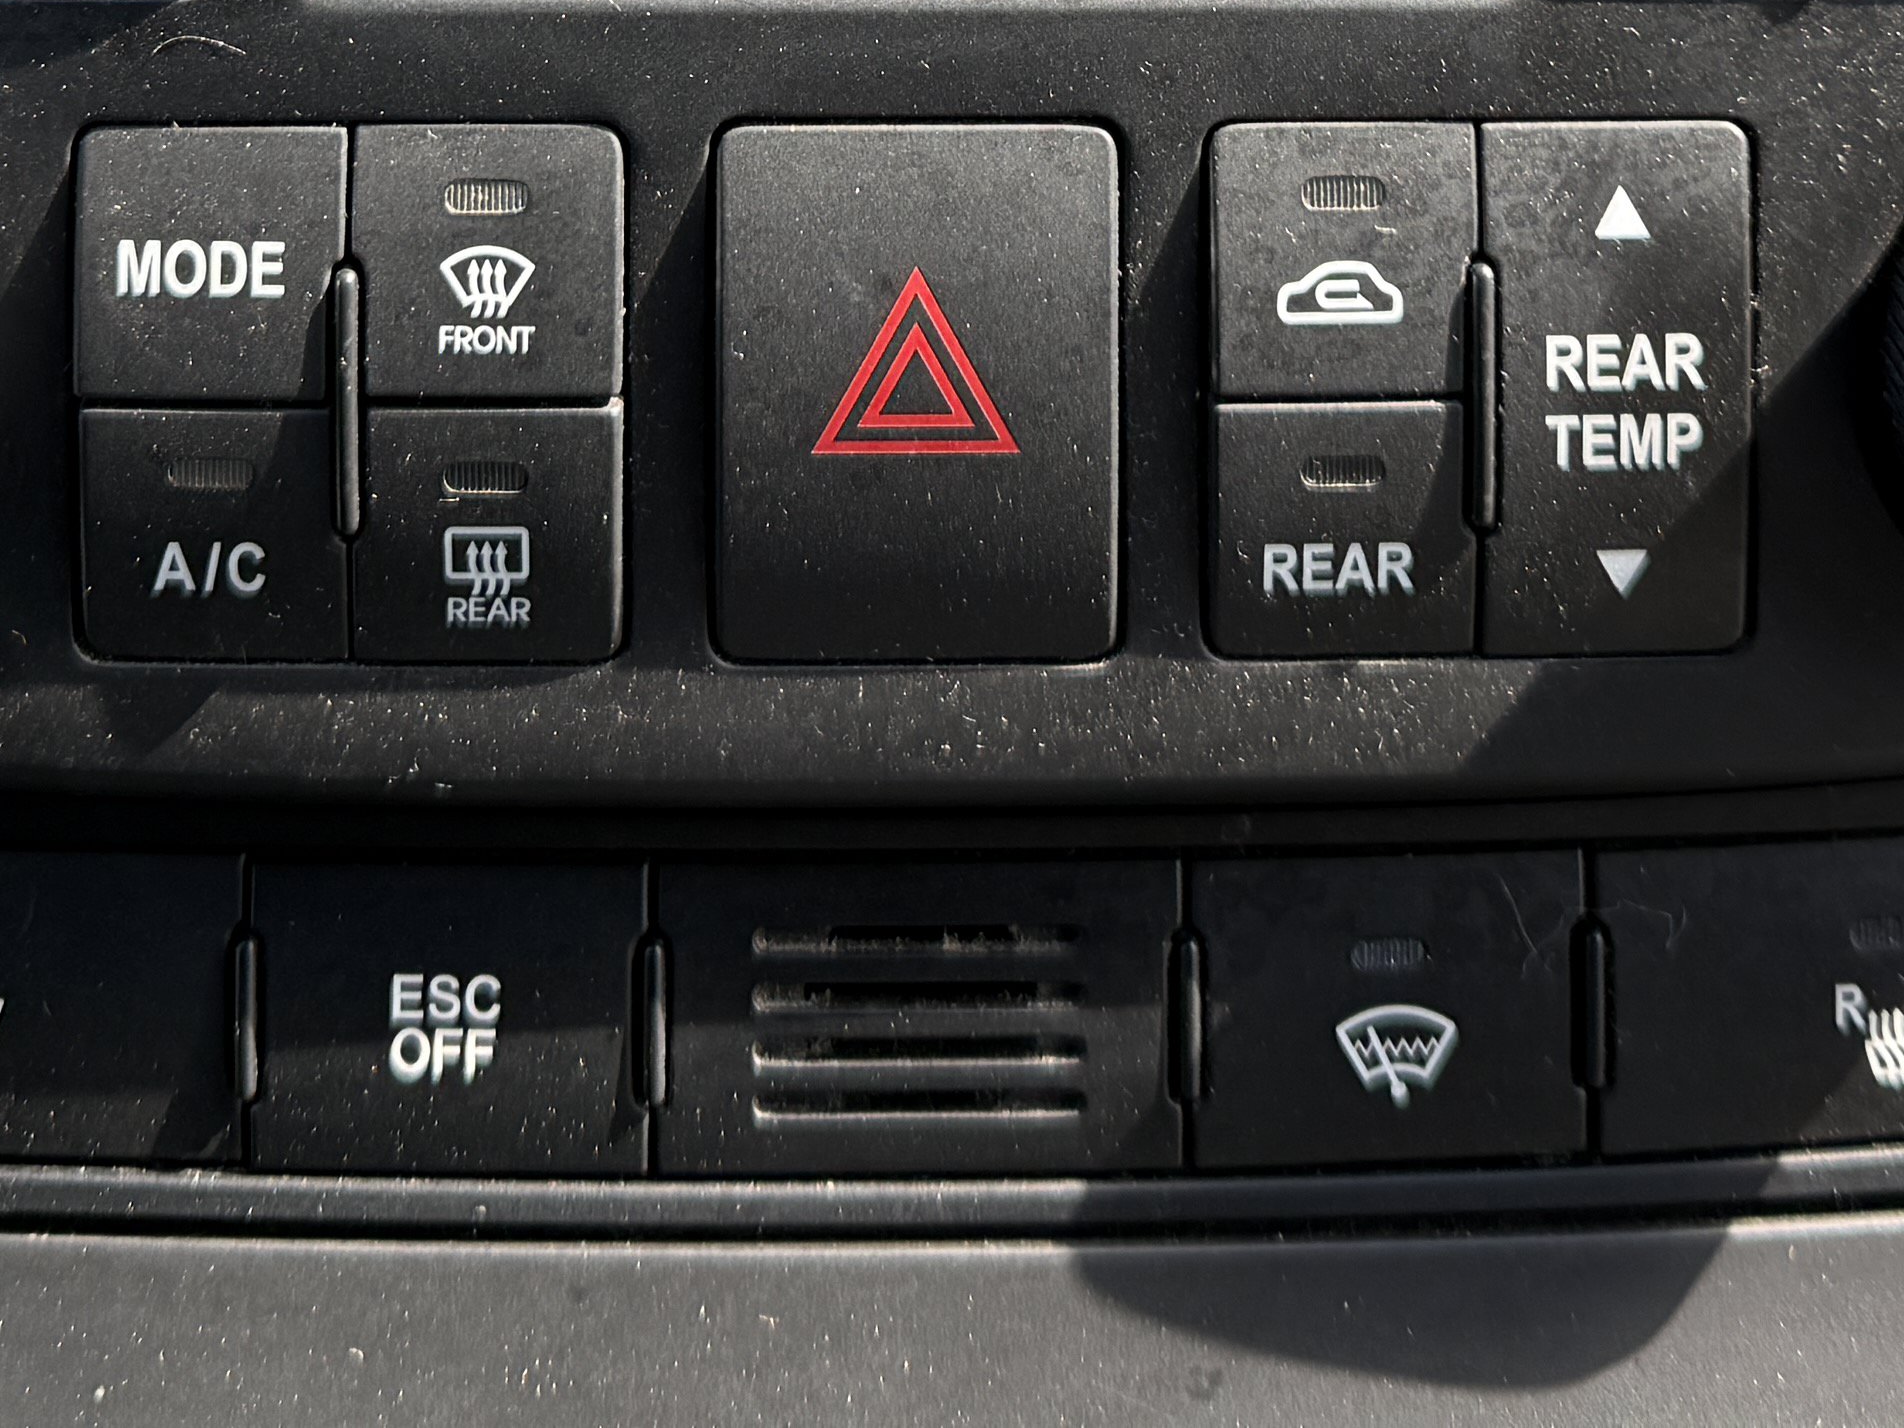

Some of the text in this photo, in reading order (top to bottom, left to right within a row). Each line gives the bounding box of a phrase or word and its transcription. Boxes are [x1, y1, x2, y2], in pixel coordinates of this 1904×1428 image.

[115, 238, 287, 298] MODE
[437, 325, 536, 354] FRONT
[1545, 332, 1706, 393] REAR
[1544, 413, 1705, 472] TEMP
[150, 541, 267, 598] A/C
[1262, 541, 1416, 597] REAR
[445, 597, 532, 629] REAR
[388, 972, 504, 1027] ESC
[1834, 982, 1869, 1037] R
[388, 1027, 496, 1085] OFF
